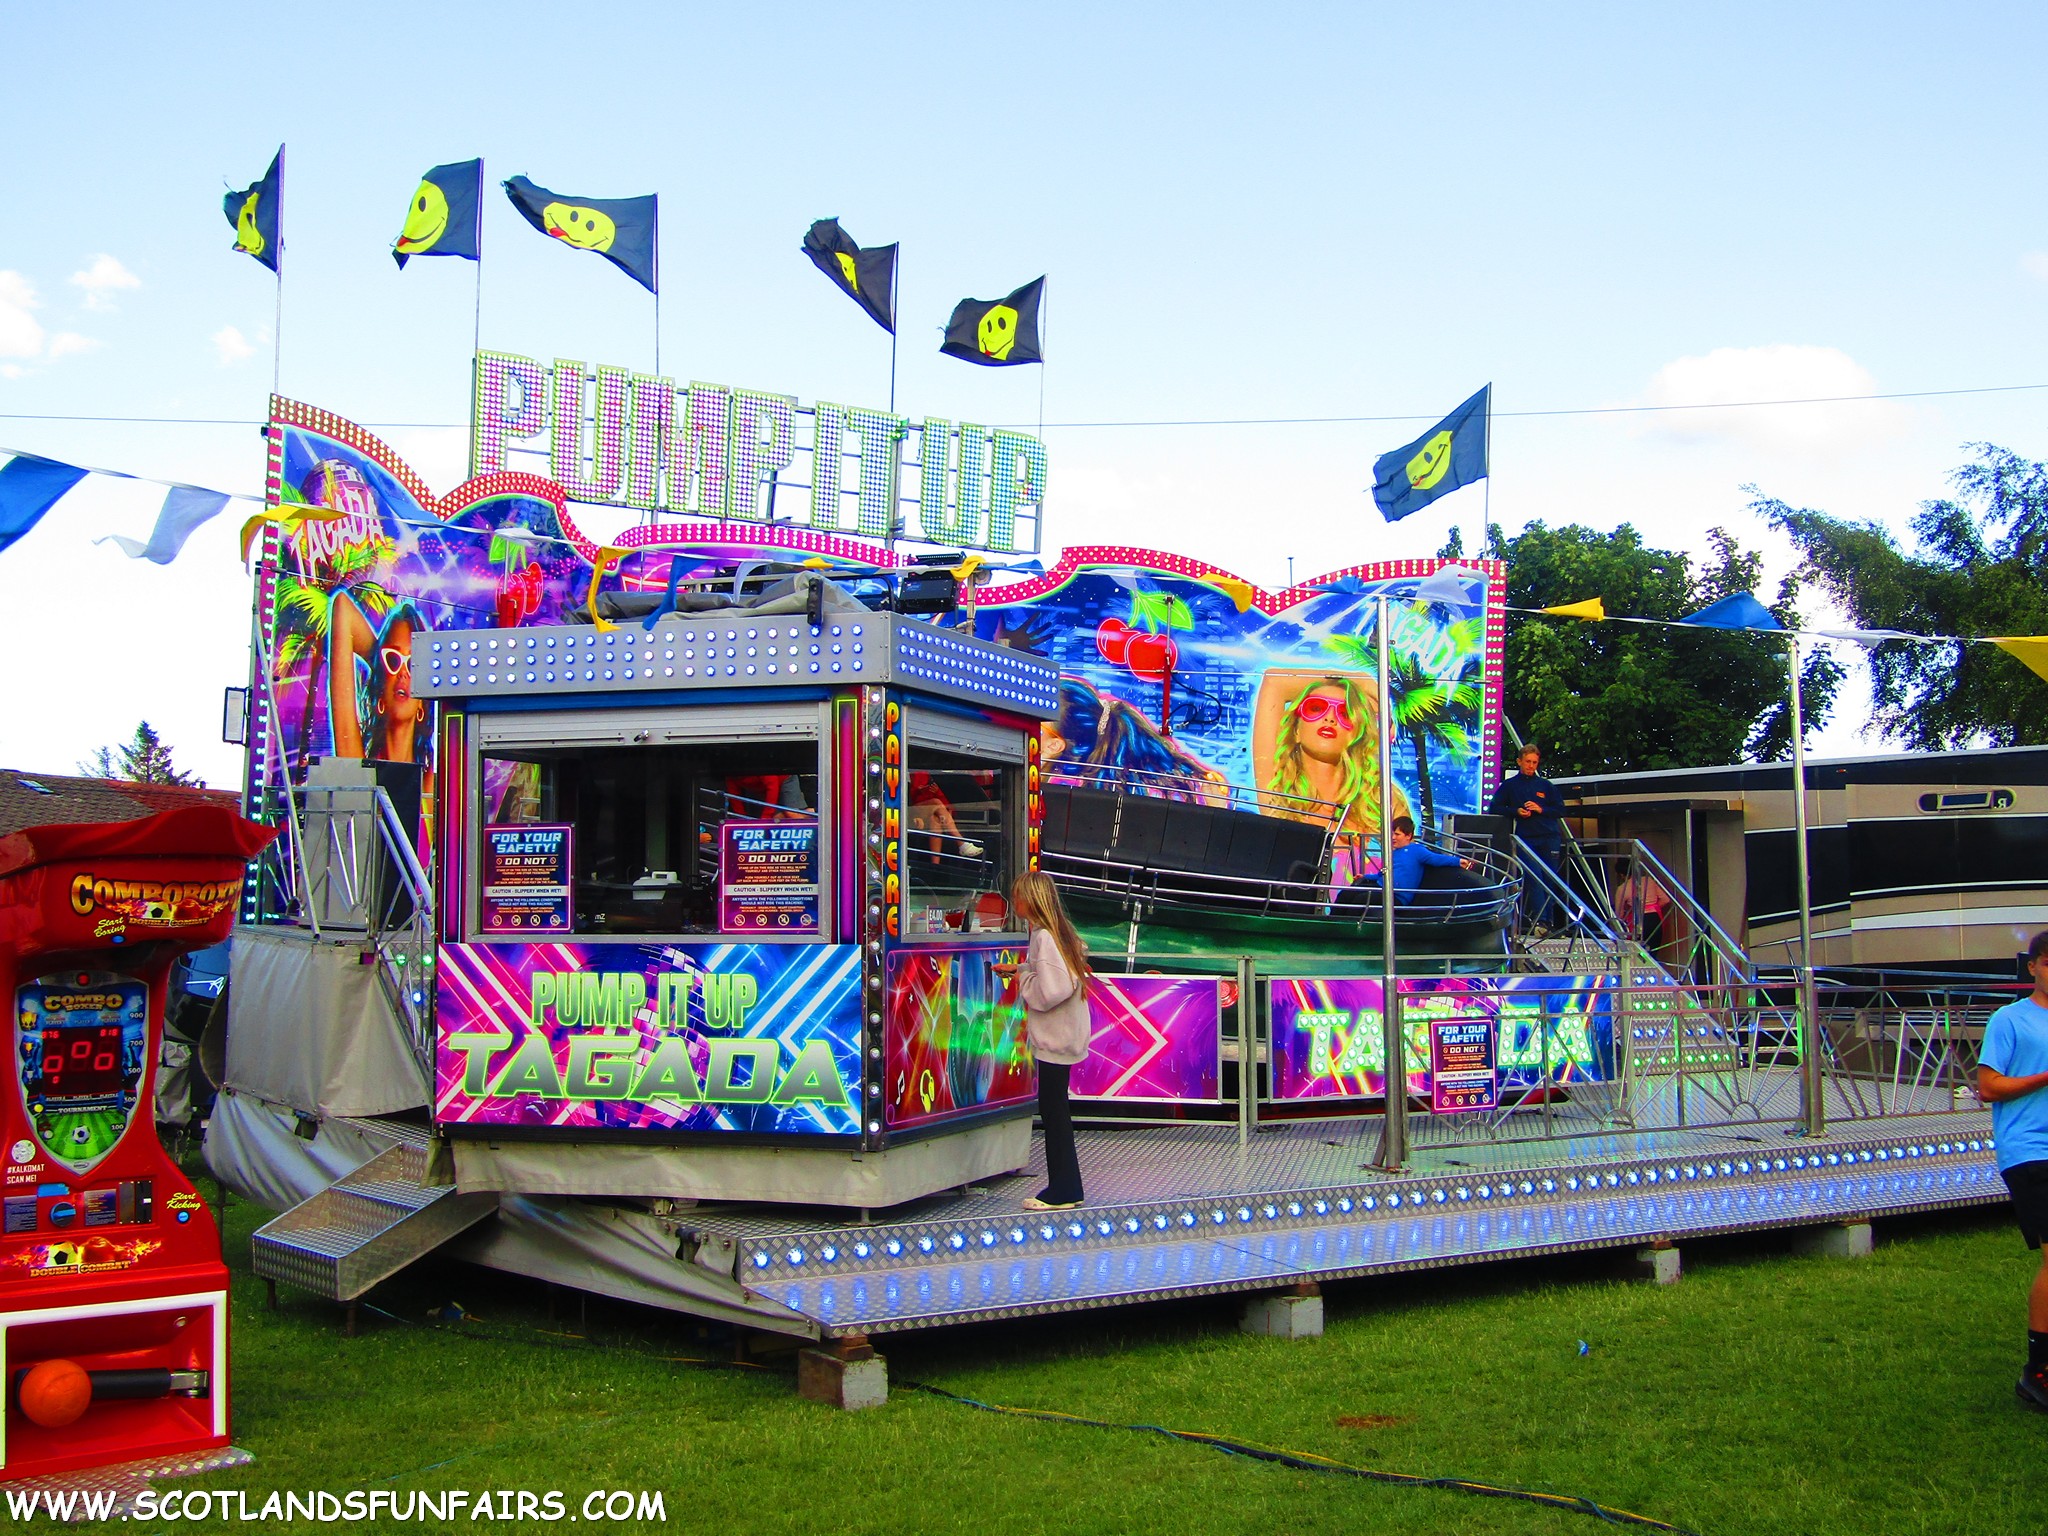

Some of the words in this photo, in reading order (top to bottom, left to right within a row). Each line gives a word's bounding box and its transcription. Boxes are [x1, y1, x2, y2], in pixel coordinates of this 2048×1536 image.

[475, 349, 797, 519] PUMP
[811, 400, 900, 536] IT
[922, 416, 1047, 551] UP
[886, 701, 900, 798] PAY
[1029, 737, 1038, 821] PAY
[491, 833, 519, 843] FOR
[524, 832, 562, 842] YOUR
[732, 830, 764, 840] FOR
[770, 829, 813, 839] YOUR
[497, 843, 557, 853] SAFETY!
[738, 840, 807, 850] SAFETY!
[524, 857, 547, 865] NOT
[886, 808, 900, 937] HERE
[98, 916, 124, 928] Start
[94, 925, 126, 937] Boxing
[44, 994, 123, 1011] COMBO
[531, 972, 646, 1027] PUMP
[658, 972, 694, 1028] IT
[704, 972, 757, 1028] UP
[1438, 1026, 1459, 1035] FOR
[1462, 1025, 1487, 1034] YOUR
[1443, 1034, 1484, 1044] SAFETY!
[448, 1033, 849, 1106] TAGADA
[7, 1164, 45, 1174] #KALKOMAT
[7, 1176, 24, 1184] SCAN
[171, 1192, 197, 1201] Start
[166, 1199, 201, 1210] Kicking
[30, 1264, 78, 1277] DOUBLE
[80, 1261, 131, 1274] COMBAT
